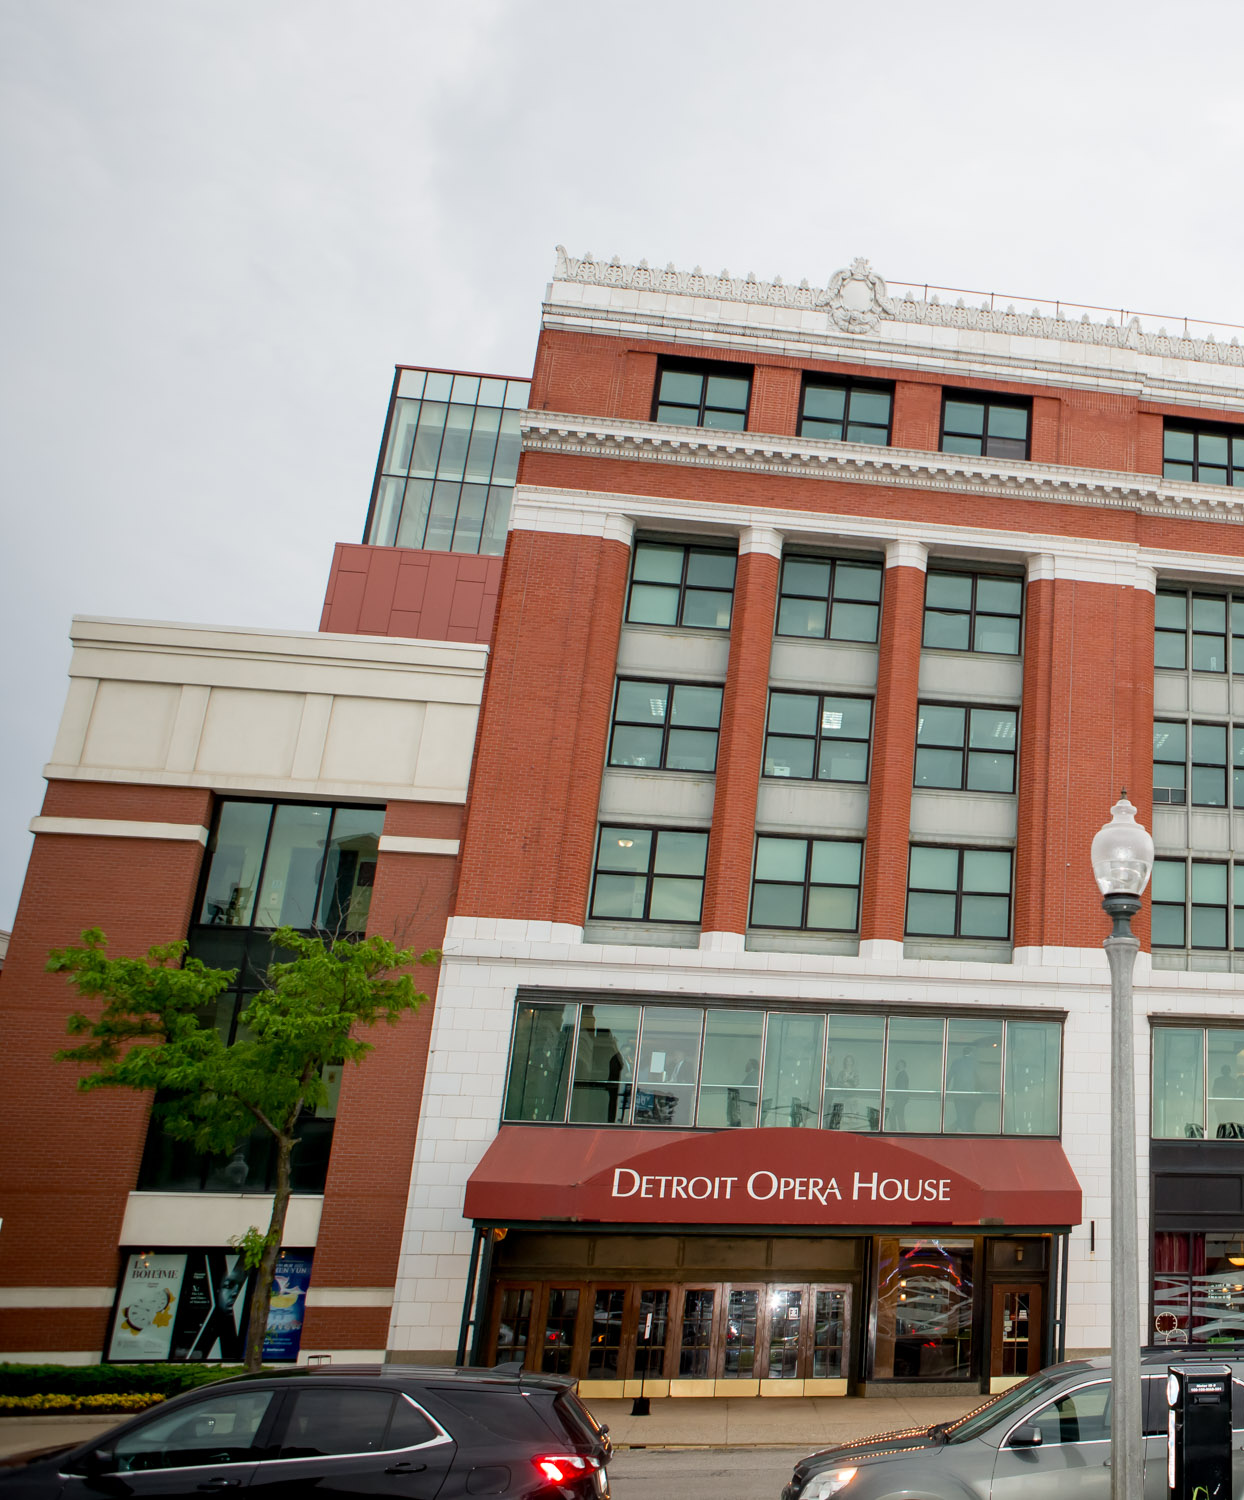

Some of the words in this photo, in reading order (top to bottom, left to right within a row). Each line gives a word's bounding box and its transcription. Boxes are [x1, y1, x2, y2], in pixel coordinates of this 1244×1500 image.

[611, 1168, 738, 1200] DETROIT
[747, 1170, 843, 1205] OPERA
[852, 1171, 951, 1202] HOUSE
